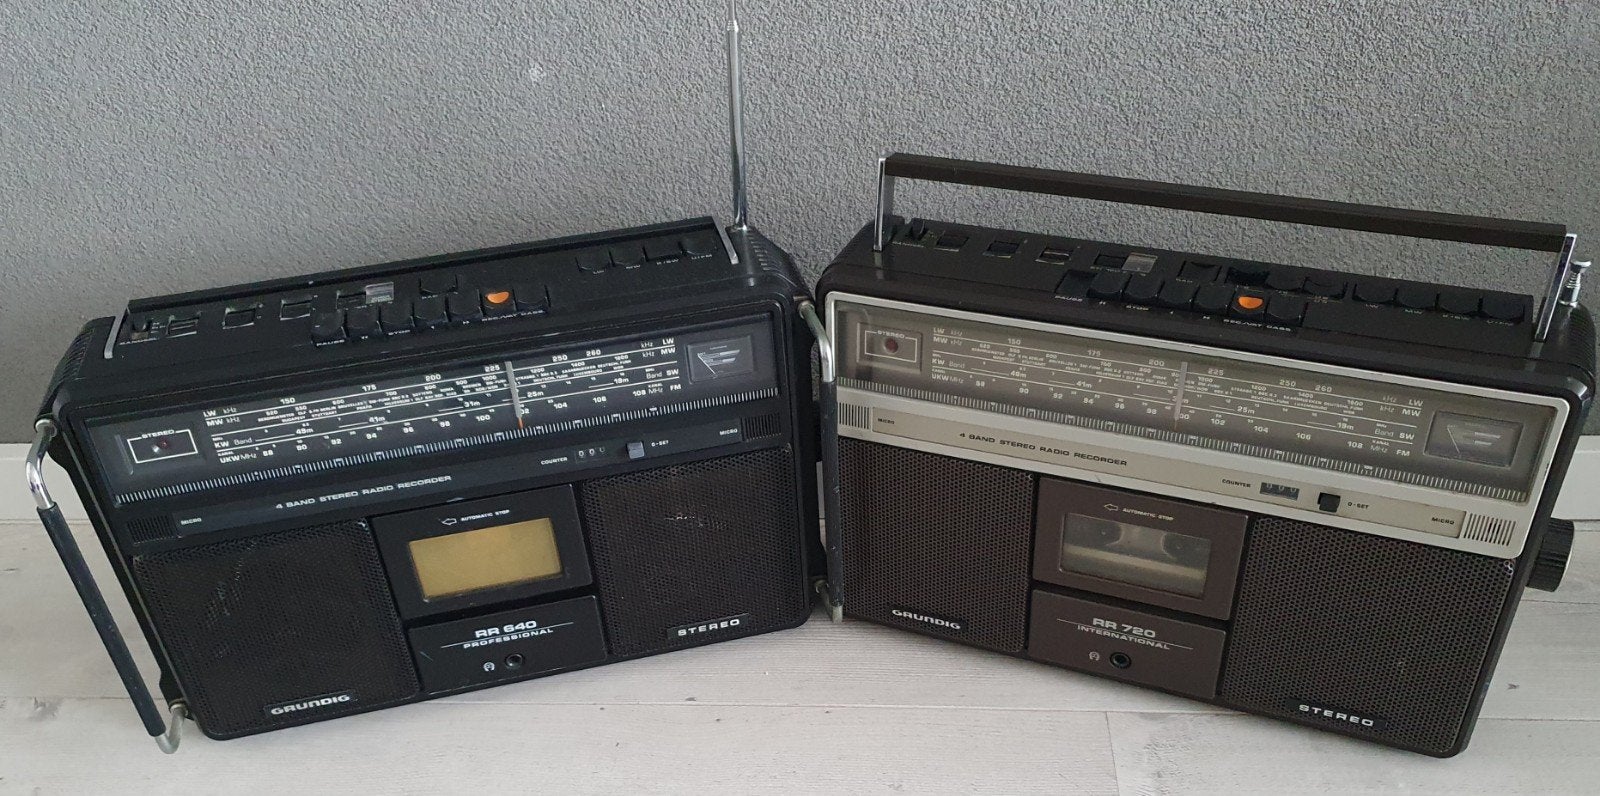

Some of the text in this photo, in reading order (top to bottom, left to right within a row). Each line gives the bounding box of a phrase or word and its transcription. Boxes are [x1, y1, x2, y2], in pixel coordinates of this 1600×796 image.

[316, 339, 345, 347] PAUSE
[877, 330, 905, 340] STEREO
[203, 410, 216, 418] LW
[223, 407, 237, 415] kHz
[280, 397, 296, 405] 150
[362, 384, 377, 392] 175
[425, 373, 441, 382] 200
[485, 364, 500, 373] 225
[552, 354, 568, 363] 250
[586, 349, 601, 357] 260
[662, 337, 674, 345] LW
[933, 327, 945, 335] LW
[1087, 349, 1101, 357] 175
[1149, 359, 1165, 367] 200
[1208, 367, 1224, 376] 225
[1279, 379, 1296, 387] 250
[1315, 384, 1332, 393] 260
[1408, 399, 1424, 407] LW
[933, 336, 948, 344] MW
[1402, 408, 1421, 417] MW
[206, 418, 223, 427] MW
[642, 350, 655, 358] kHz
[660, 347, 676, 355] MW
[233, 437, 253, 446] Band
[646, 371, 662, 379] Band
[666, 368, 679, 376] SW
[948, 361, 965, 369] Band
[1076, 380, 1092, 388] 41m
[1237, 405, 1255, 414] 25m
[1337, 422, 1354, 430] 19m
[1374, 428, 1394, 437] Band
[220, 455, 240, 464] UKW
[240, 453, 257, 461] MHz
[476, 414, 491, 422] 100
[554, 402, 568, 410] 104
[670, 383, 681, 391] FM
[931, 373, 949, 382] UKW
[1211, 418, 1226, 426] 102
[1253, 425, 1269, 433] 104
[1296, 432, 1311, 440] 106
[1347, 441, 1363, 449] 108
[1370, 445, 1388, 454] MHz
[1396, 449, 1411, 457] FM
[141, 430, 175, 439] STEREO
[719, 428, 738, 437] MICRO
[968, 434, 995, 443] BAND
[999, 439, 1036, 450] STEREO
[1039, 446, 1070, 456] RADIO
[1073, 452, 1128, 466] RECORDER
[540, 457, 568, 465] COUNTER
[286, 497, 316, 508] BAND
[319, 491, 358, 502] STEREO
[362, 485, 394, 495] RADIO
[398, 476, 452, 489] RECORDER
[1221, 478, 1251, 488] COUNTER
[180, 517, 202, 526] MICRO
[461, 512, 494, 522] AUTOMATIC
[1122, 507, 1155, 518] AUTOMATIC
[1431, 516, 1455, 526] MICRO
[475, 620, 538, 638] RR 640
[677, 618, 740, 636] STEREO
[891, 609, 961, 630] GRUNDIG
[1092, 617, 1156, 638] RR 720
[463, 627, 554, 649] PROFESSIONAL
[1077, 624, 1170, 650] INTERNATIONAL
[271, 694, 350, 716] GRUNDIG
[1298, 704, 1374, 727] STEREO
